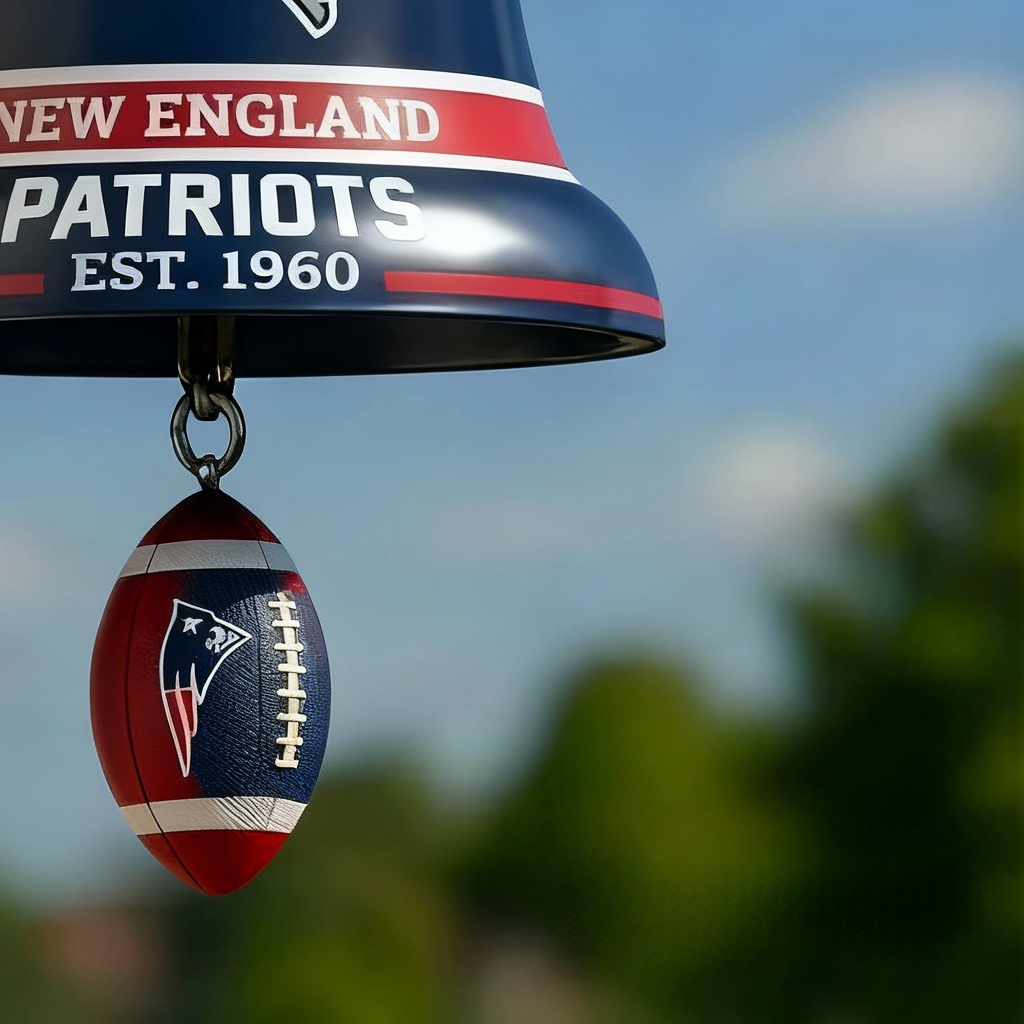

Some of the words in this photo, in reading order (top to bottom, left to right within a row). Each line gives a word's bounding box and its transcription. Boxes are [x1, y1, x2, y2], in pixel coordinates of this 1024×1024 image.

[143, 93, 441, 143] ENGLAND
[0, 172, 428, 244] PATRIOTS
[70, 250, 200, 293] EST.
[221, 249, 360, 292] 1960
